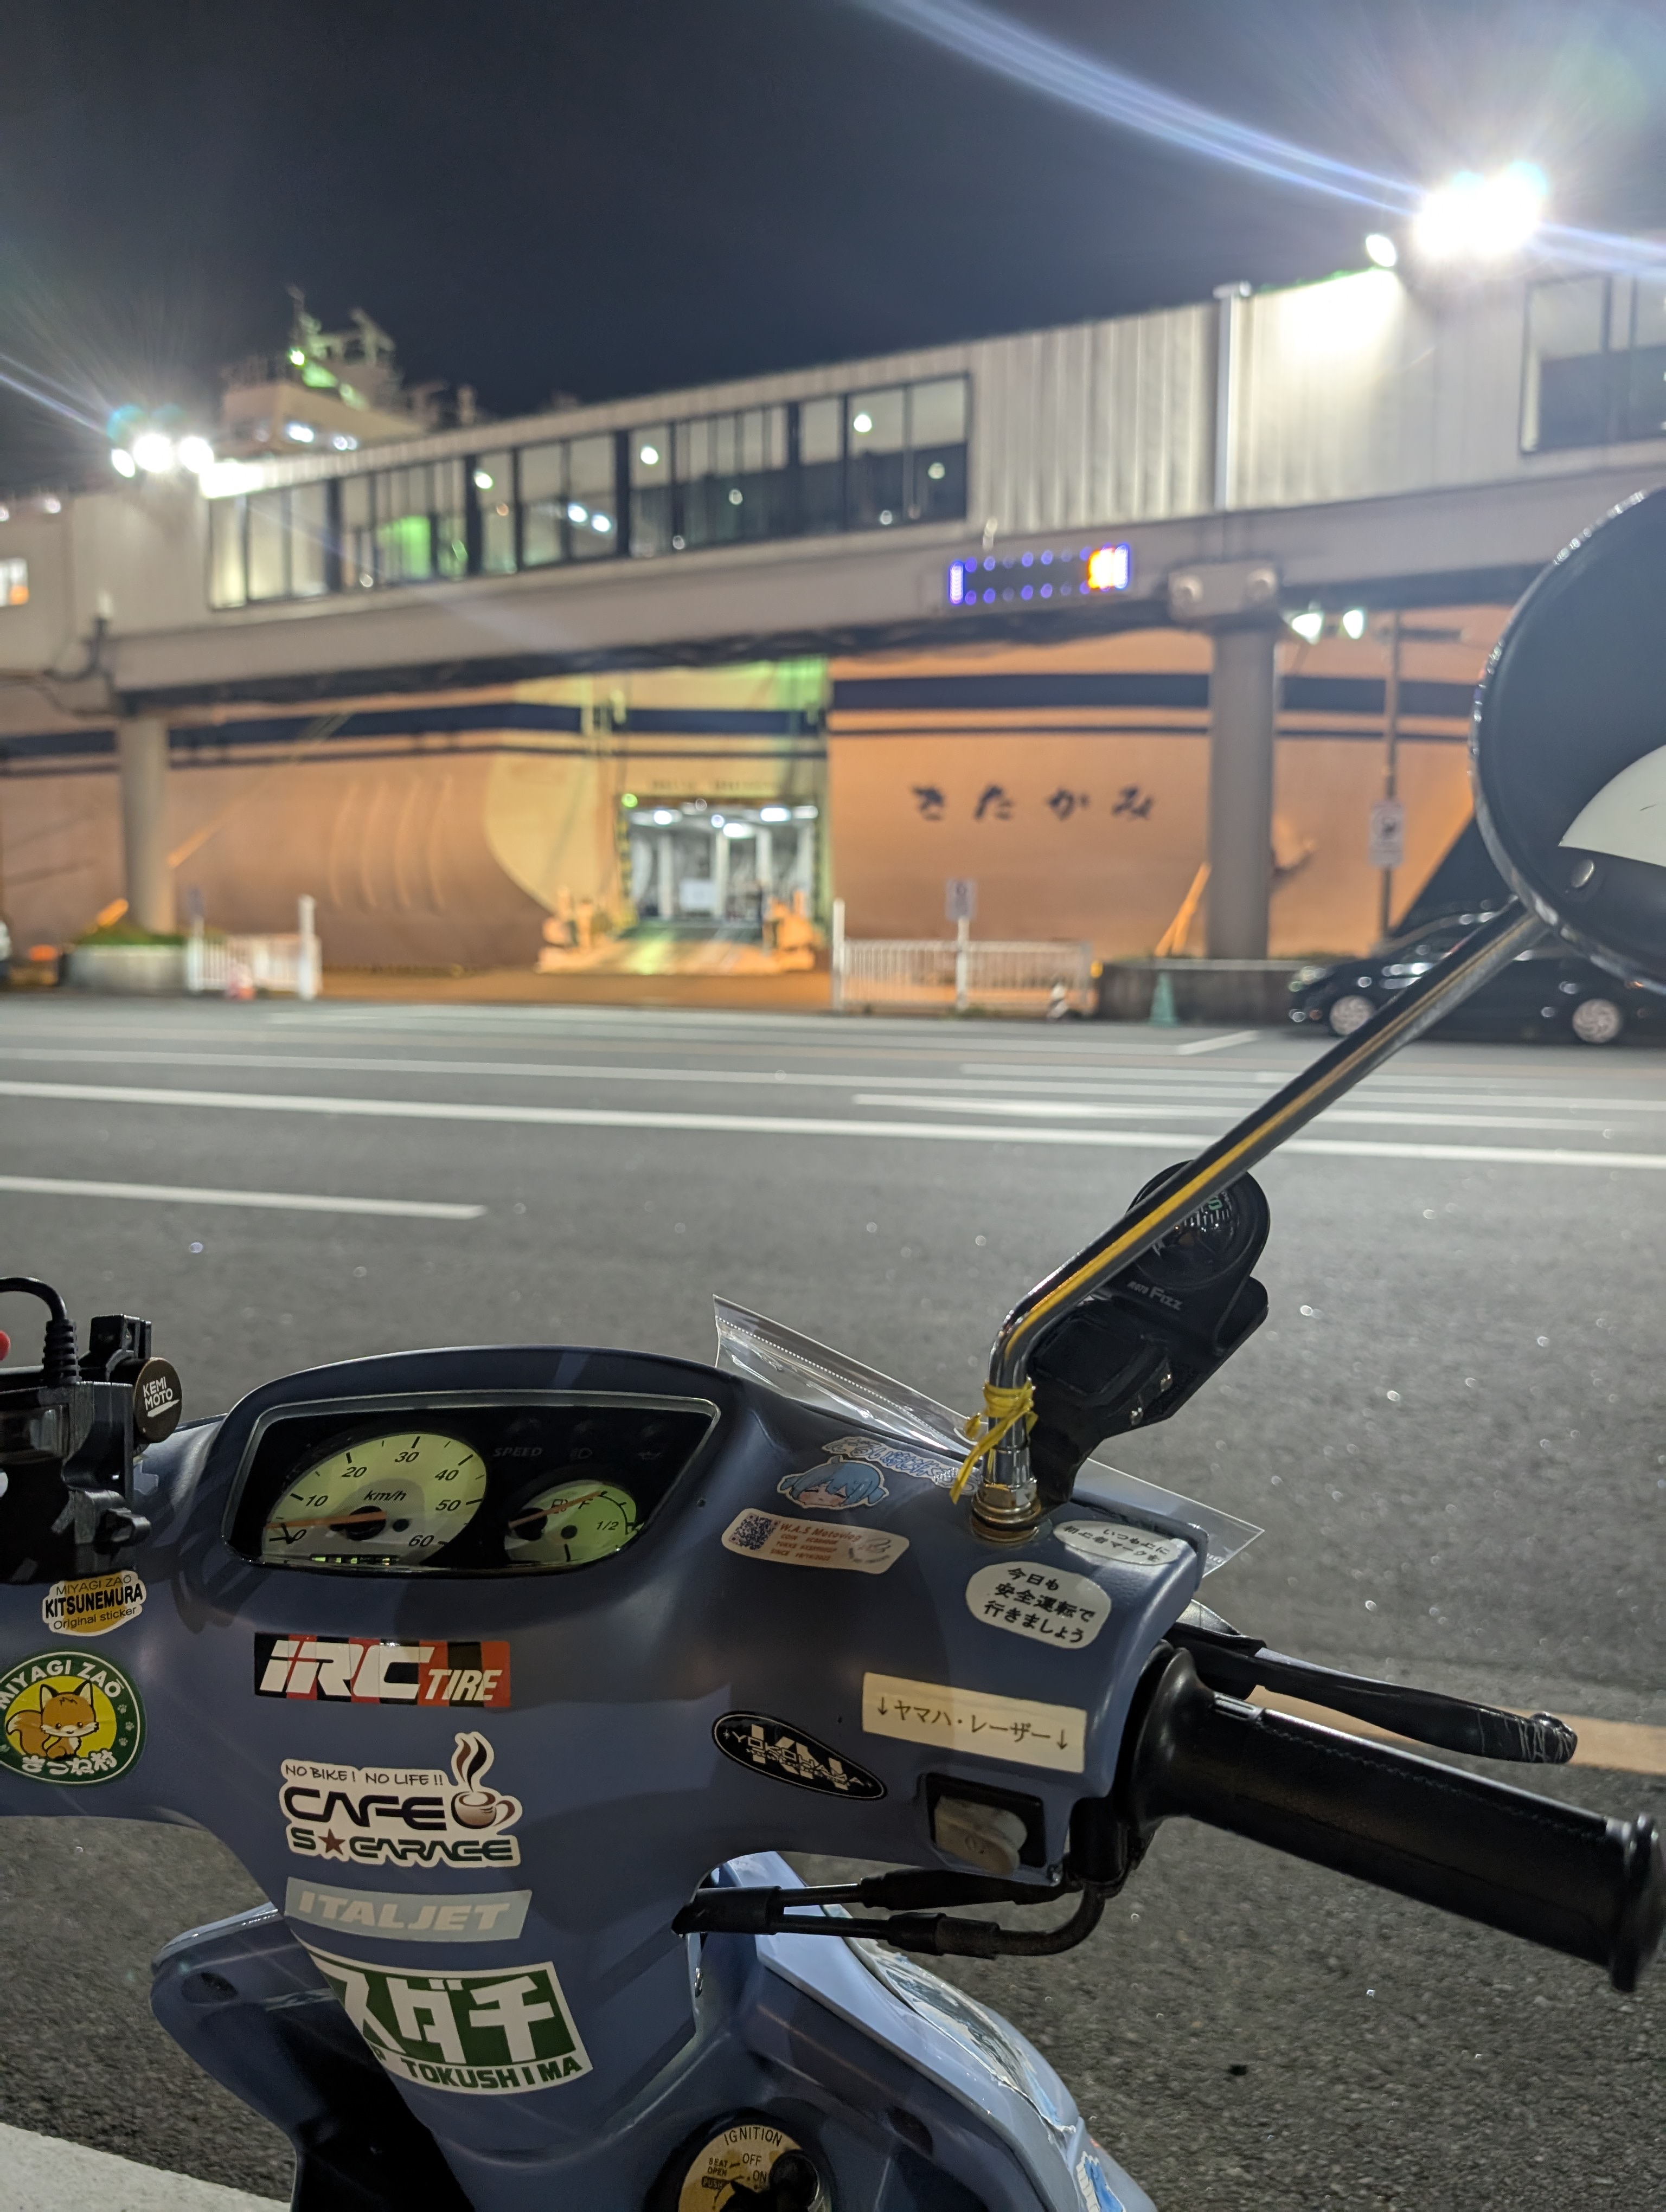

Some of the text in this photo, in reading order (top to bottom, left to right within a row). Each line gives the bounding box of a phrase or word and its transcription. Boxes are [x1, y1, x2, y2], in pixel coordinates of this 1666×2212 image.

[143, 1377, 167, 1398] KEMI
[144, 1387, 173, 1411] MOTO
[394, 1451, 420, 1462] 30
[493, 1447, 542, 1457] SPEED
[341, 1467, 368, 1478] 20
[434, 1469, 459, 1481] 40
[305, 1495, 328, 1507] 10
[363, 1490, 407, 1501] km/h
[435, 1500, 462, 1511] 50
[293, 1529, 306, 1541] 0
[597, 1521, 619, 1531] 1/2
[408, 1535, 434, 1547] 60
[56, 1580, 101, 1595] MIYAGI
[1008, 1568, 1059, 1591] 今日も
[45, 1583, 143, 1619] KITSUNEMURA
[995, 1583, 1095, 1623] 安全運転で
[54, 1607, 137, 1630] Original sticker
[984, 1600, 1084, 1643] 行きましょう
[0, 1660, 72, 1710] MIYAGI
[425, 1669, 503, 1701] TIRE
[894, 1700, 1050, 1742] ヤマハ・レーザー
[22, 1749, 117, 1776] きつね村
[732, 1731, 866, 1786] YOKOHAMA
[285, 1764, 307, 1777] NO
[365, 1772, 389, 1785] NO
[284, 1786, 447, 1831] CAFE
[299, 1891, 510, 1931] ITALJET
[320, 1965, 554, 2063] スダチ
[400, 2056, 582, 2088] TOKUSHIMA
[724, 2127, 783, 2146] IGNITION
[742, 2153, 762, 2166] OFF
[707, 2166, 727, 2176] OPEN
[753, 2170, 767, 2183] ON
